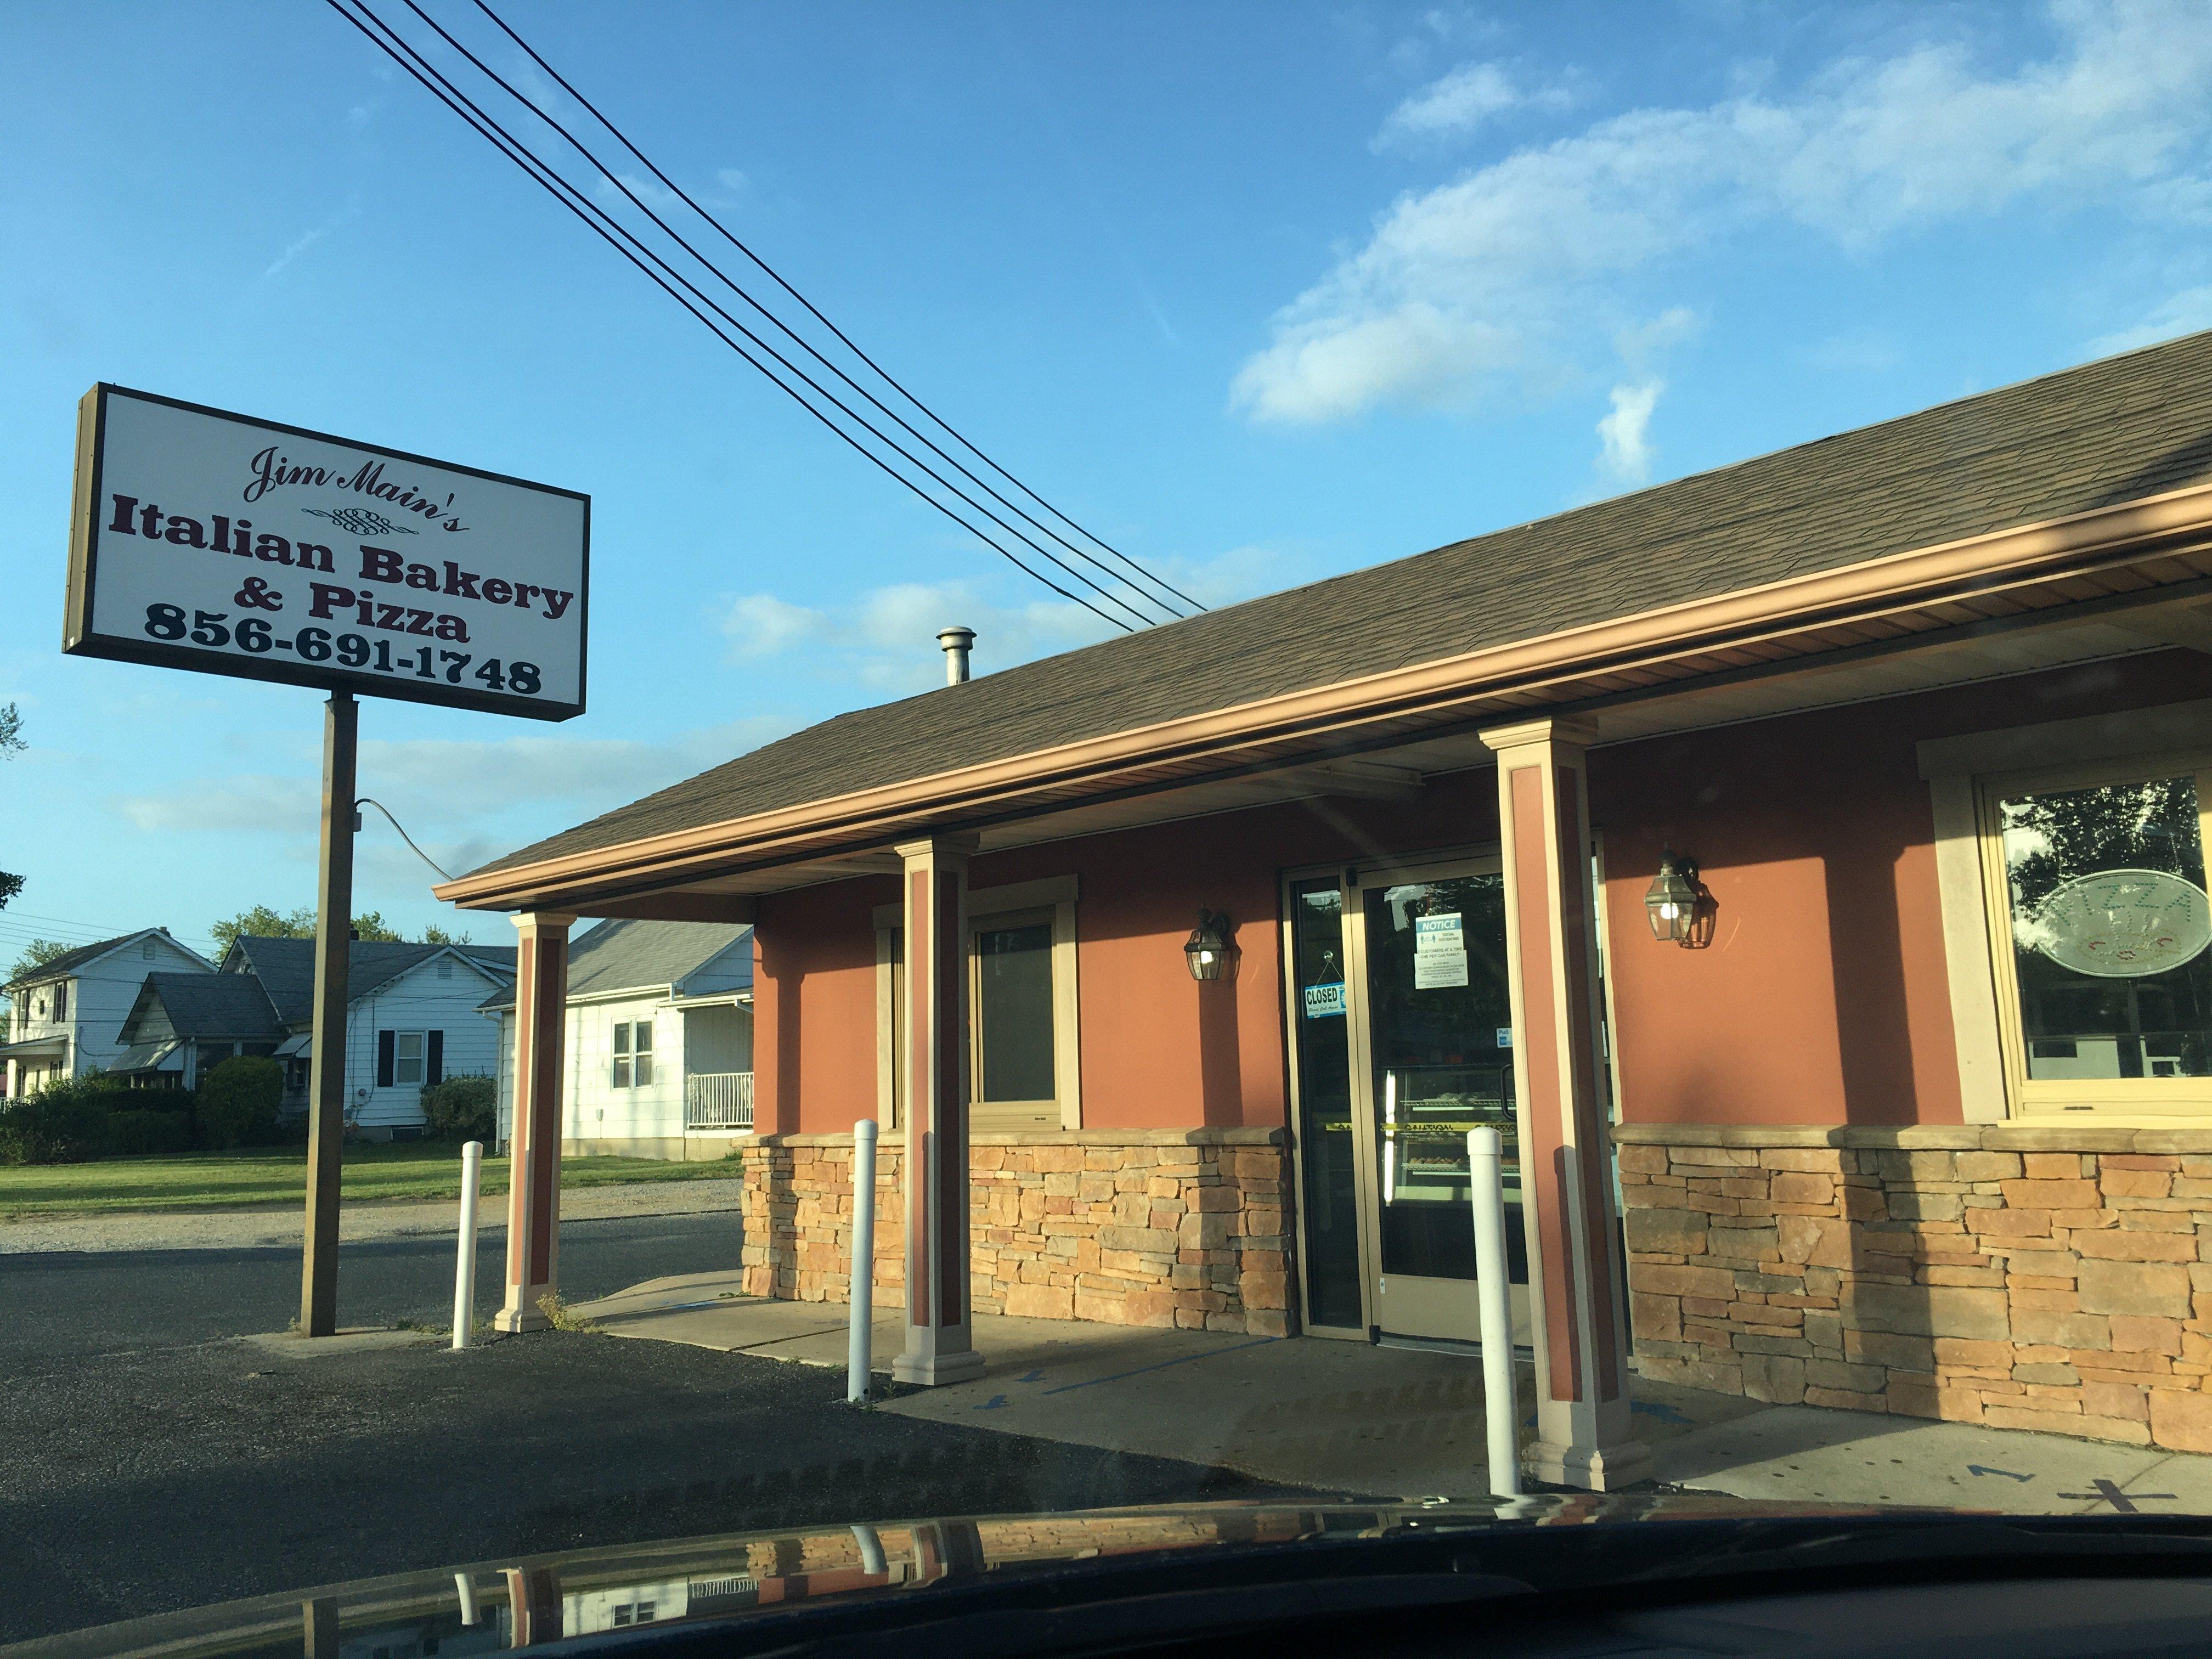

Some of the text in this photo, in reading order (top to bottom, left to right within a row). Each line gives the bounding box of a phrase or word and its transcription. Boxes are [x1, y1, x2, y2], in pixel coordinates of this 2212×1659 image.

[243, 447, 470, 532] Jim Main's
[109, 493, 573, 619] Italian Bakery
[234, 577, 471, 643] & Pizza
[144, 602, 541, 694] 856-691-1748
[1422, 919, 1456, 931] NOTICE
[1307, 987, 1338, 1005] CLOSED
